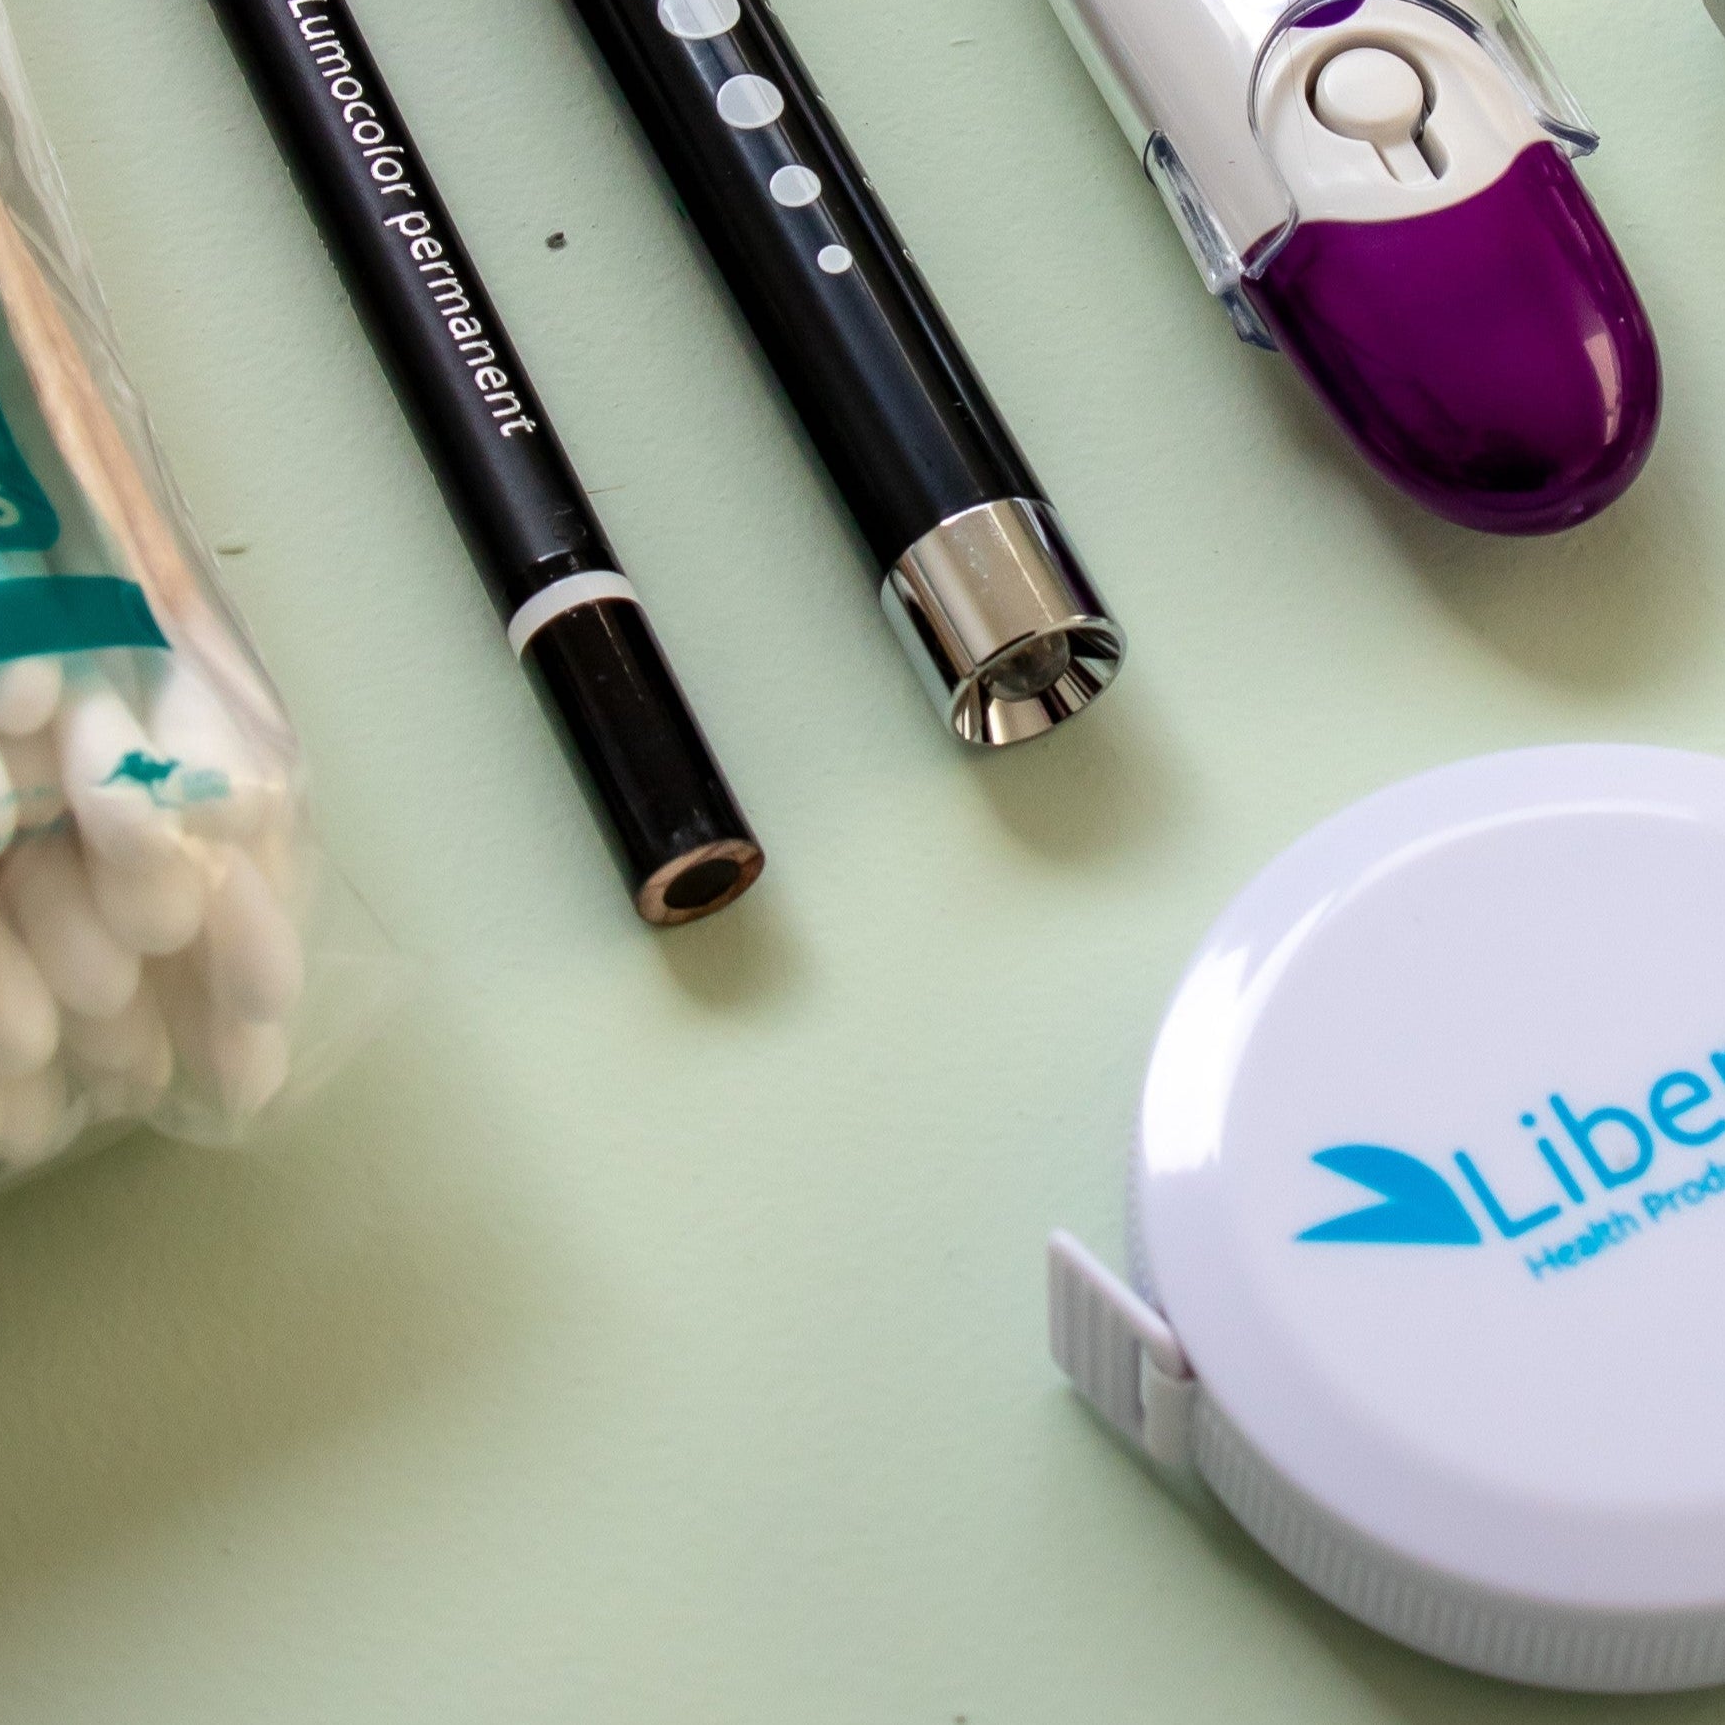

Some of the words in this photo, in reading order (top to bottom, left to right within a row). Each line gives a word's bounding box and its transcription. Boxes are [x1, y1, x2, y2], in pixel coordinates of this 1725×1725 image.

[383, 209, 537, 438] permanent
[1453, 1051, 1725, 1238] Libe
[1524, 1210, 1641, 1280] Health
